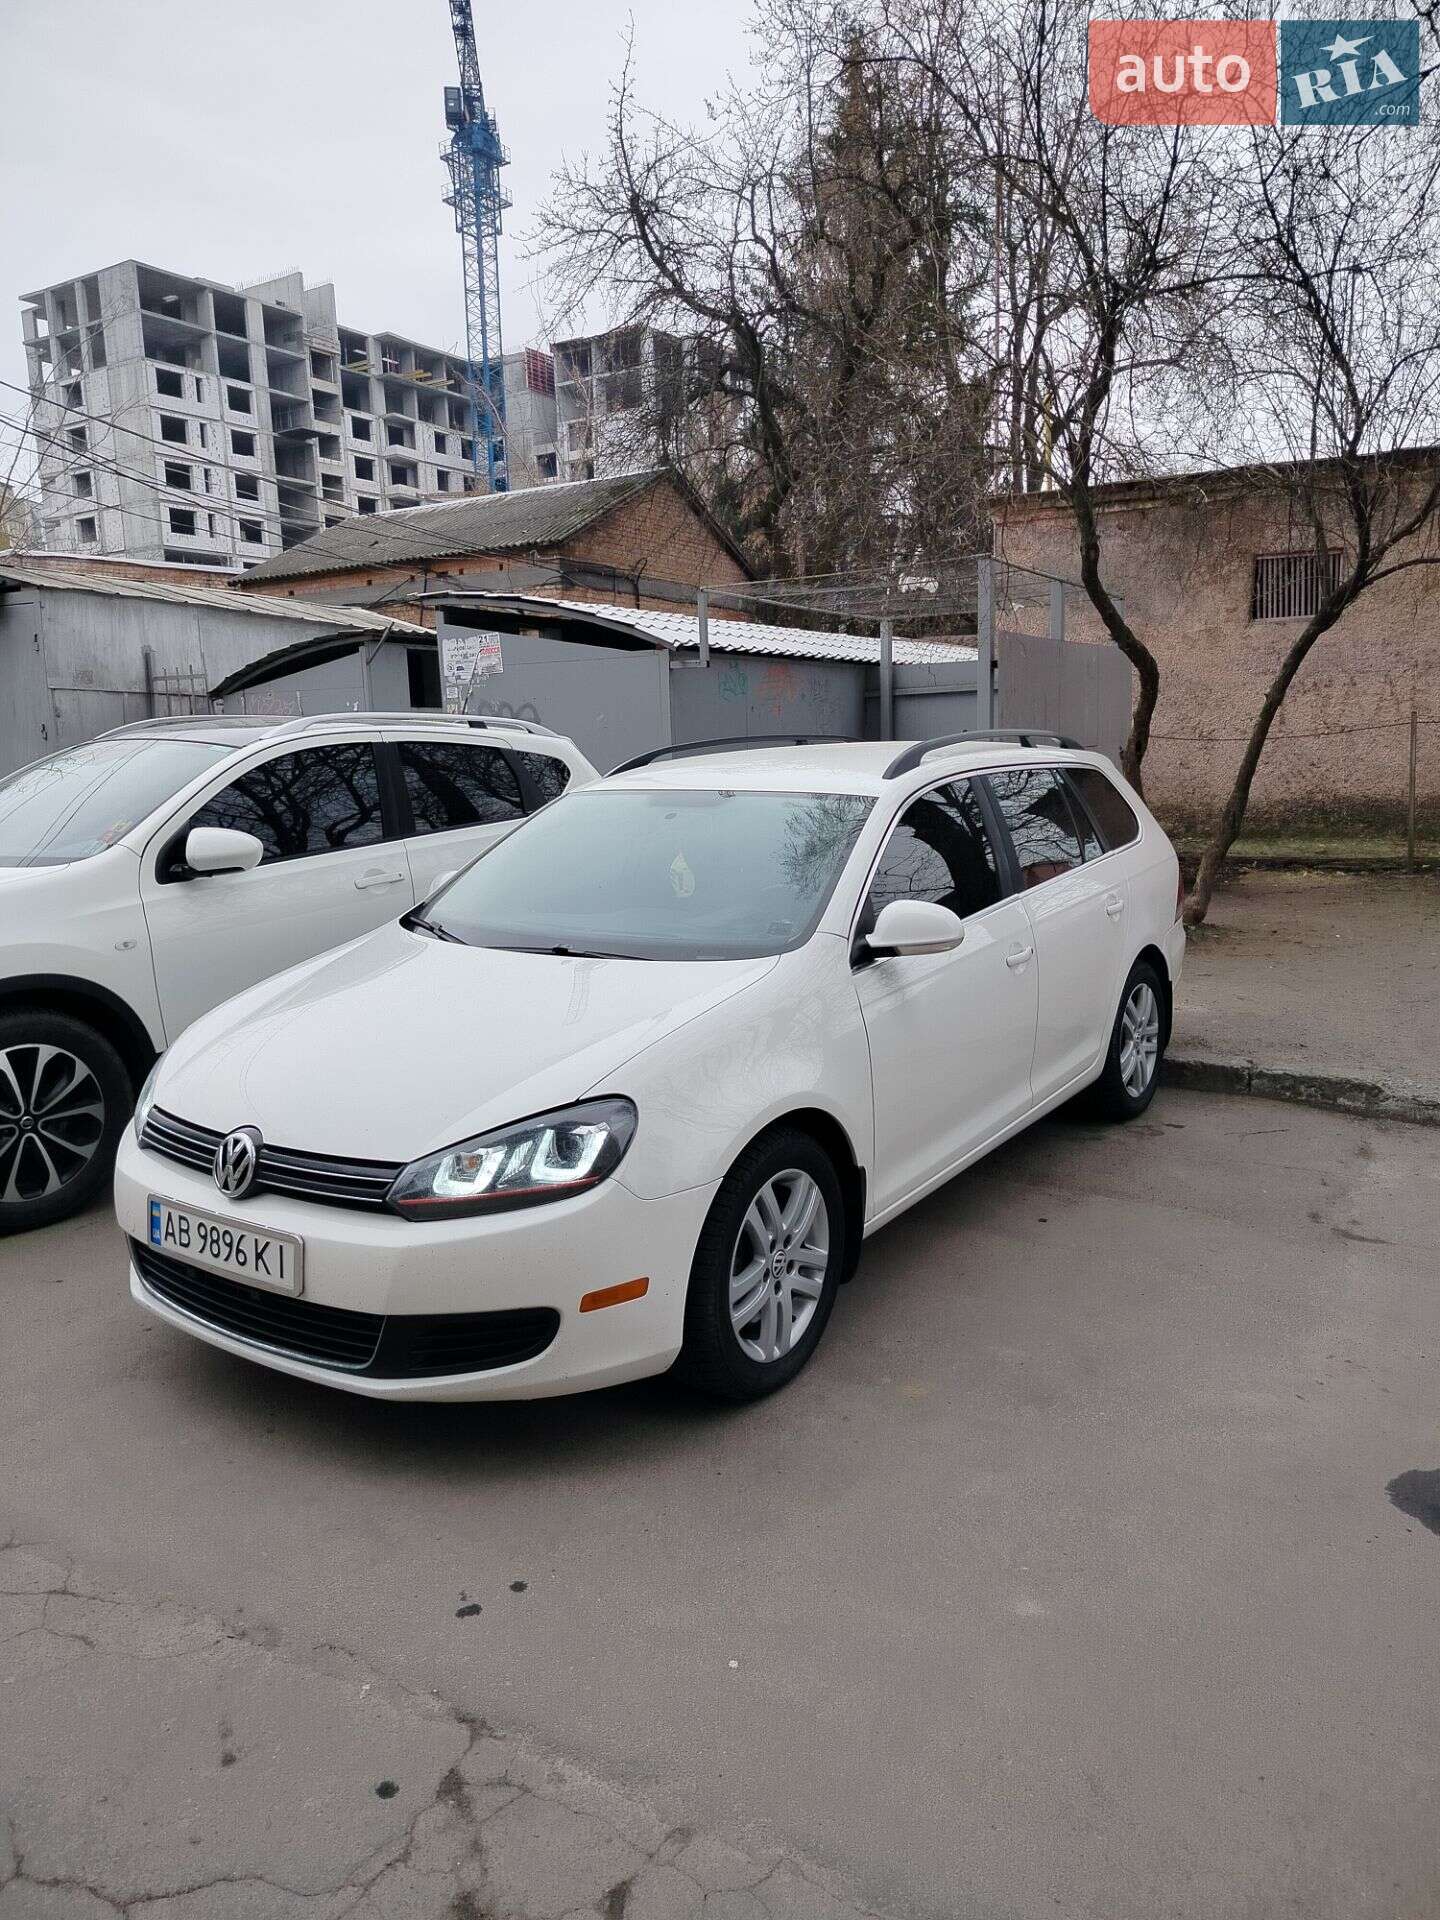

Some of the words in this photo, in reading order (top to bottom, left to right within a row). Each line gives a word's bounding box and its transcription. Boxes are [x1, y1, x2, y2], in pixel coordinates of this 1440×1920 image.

[164, 1210, 191, 1249] AB
[196, 1221, 248, 1267] 9896
[254, 1237, 284, 1279] KI
